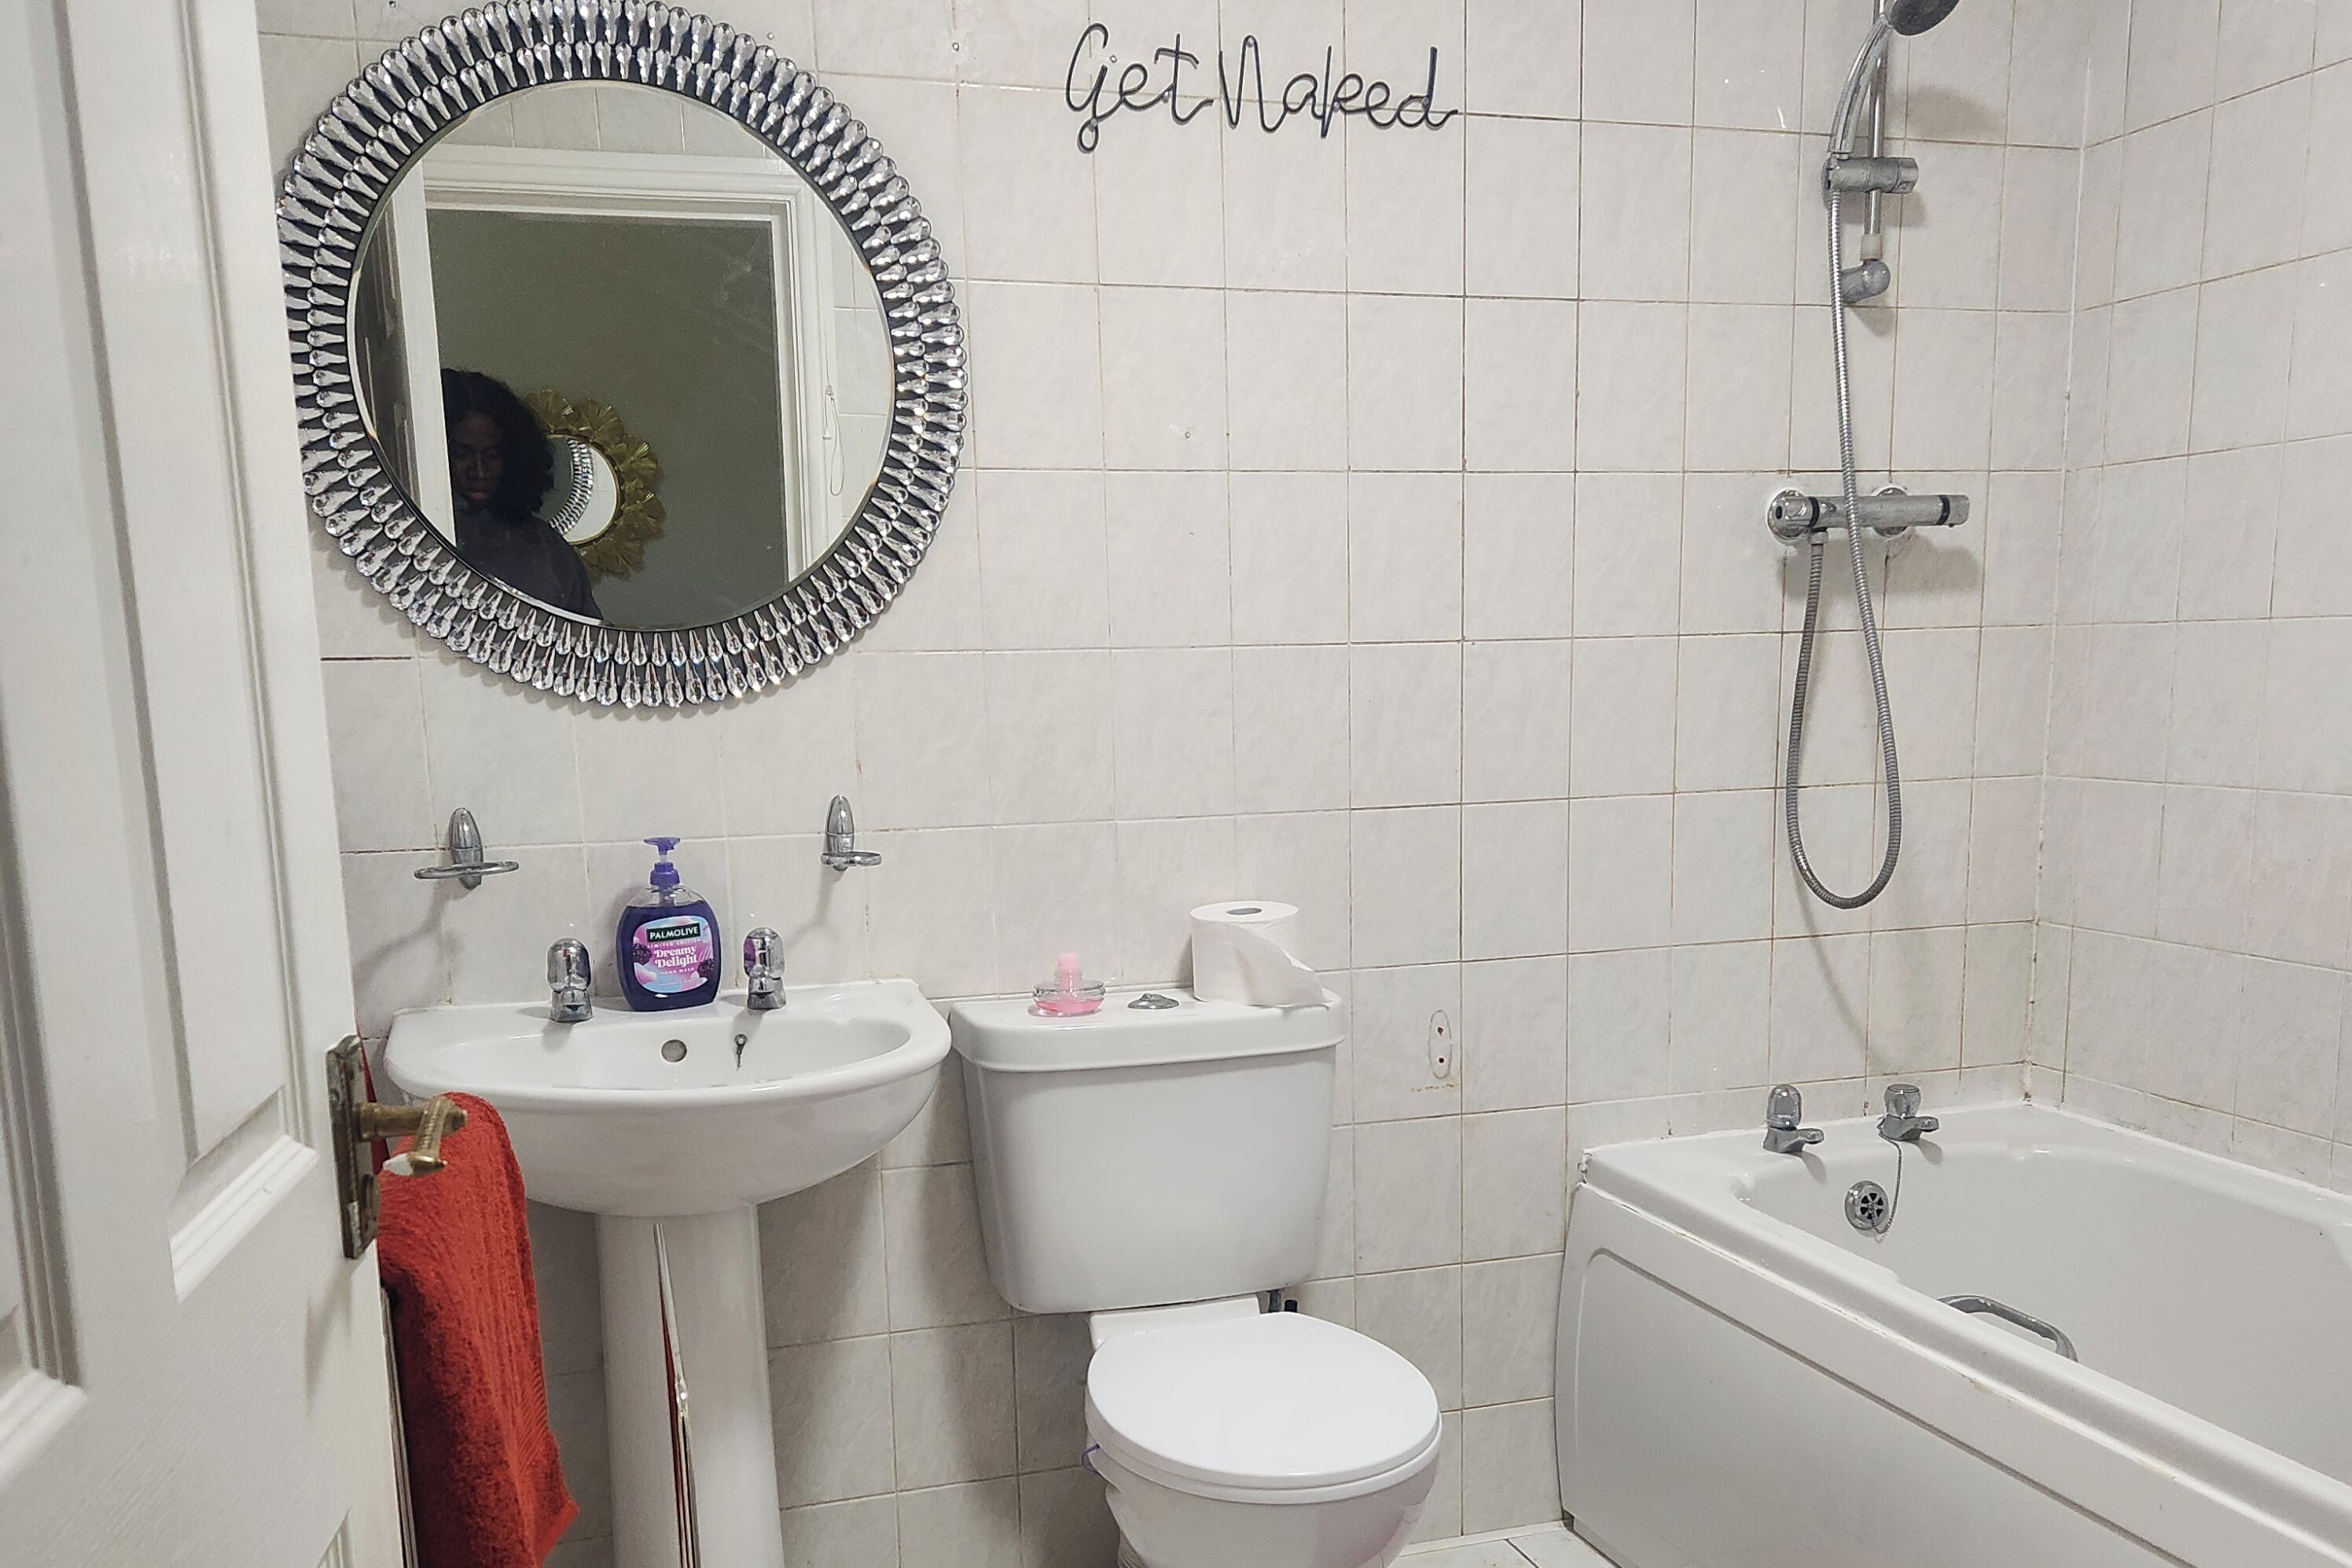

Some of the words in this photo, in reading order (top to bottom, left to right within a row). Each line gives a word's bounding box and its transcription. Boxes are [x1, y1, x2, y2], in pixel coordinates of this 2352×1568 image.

[1065, 22, 1215, 152] Get
[1218, 35, 1459, 140] Naked
[649, 926, 698, 940] PALMOLIVE
[654, 946, 696, 958] Dreamy
[655, 955, 697, 968] Delight
